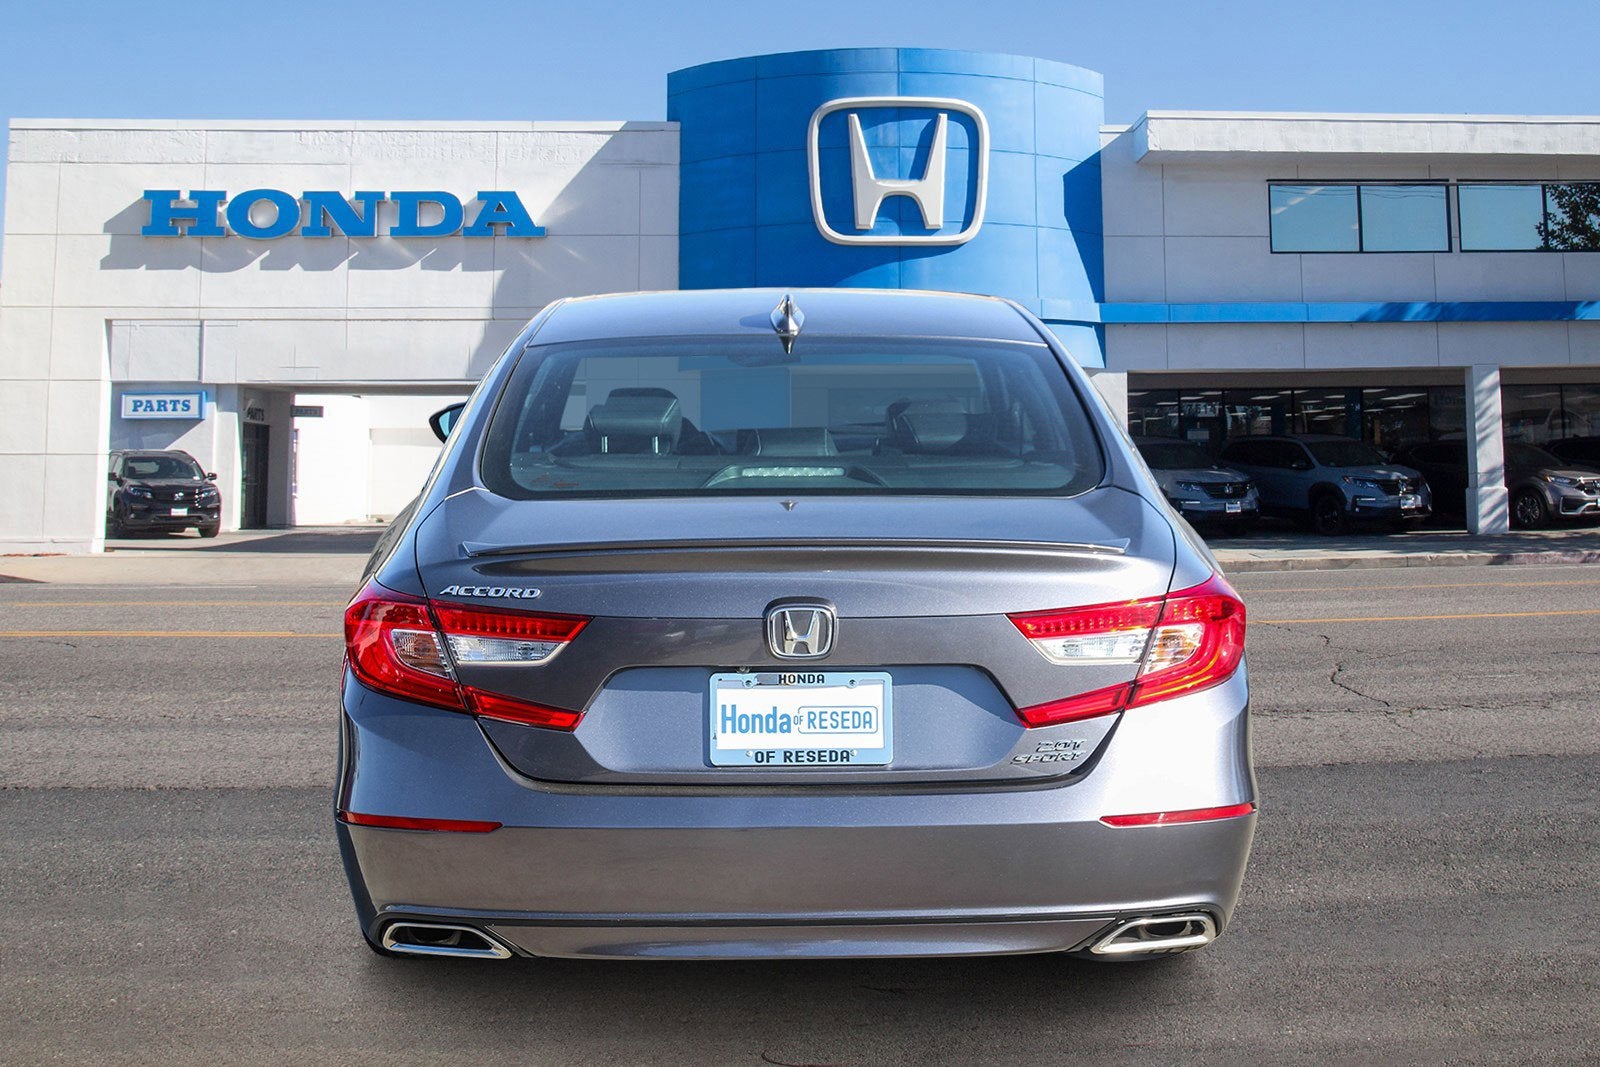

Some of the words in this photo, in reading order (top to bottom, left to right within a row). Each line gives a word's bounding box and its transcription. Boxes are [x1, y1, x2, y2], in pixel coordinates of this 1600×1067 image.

[141, 189, 547, 239] HONDA
[132, 399, 191, 412] PARTS
[440, 585, 542, 599] ACCORD
[778, 674, 825, 685] HONDA
[721, 704, 792, 734] Honda
[793, 715, 804, 726] OF
[807, 711, 872, 729] RESEDA
[754, 750, 775, 763] OF
[783, 750, 850, 763] RESEDA
[1010, 751, 1087, 765] SPORT
